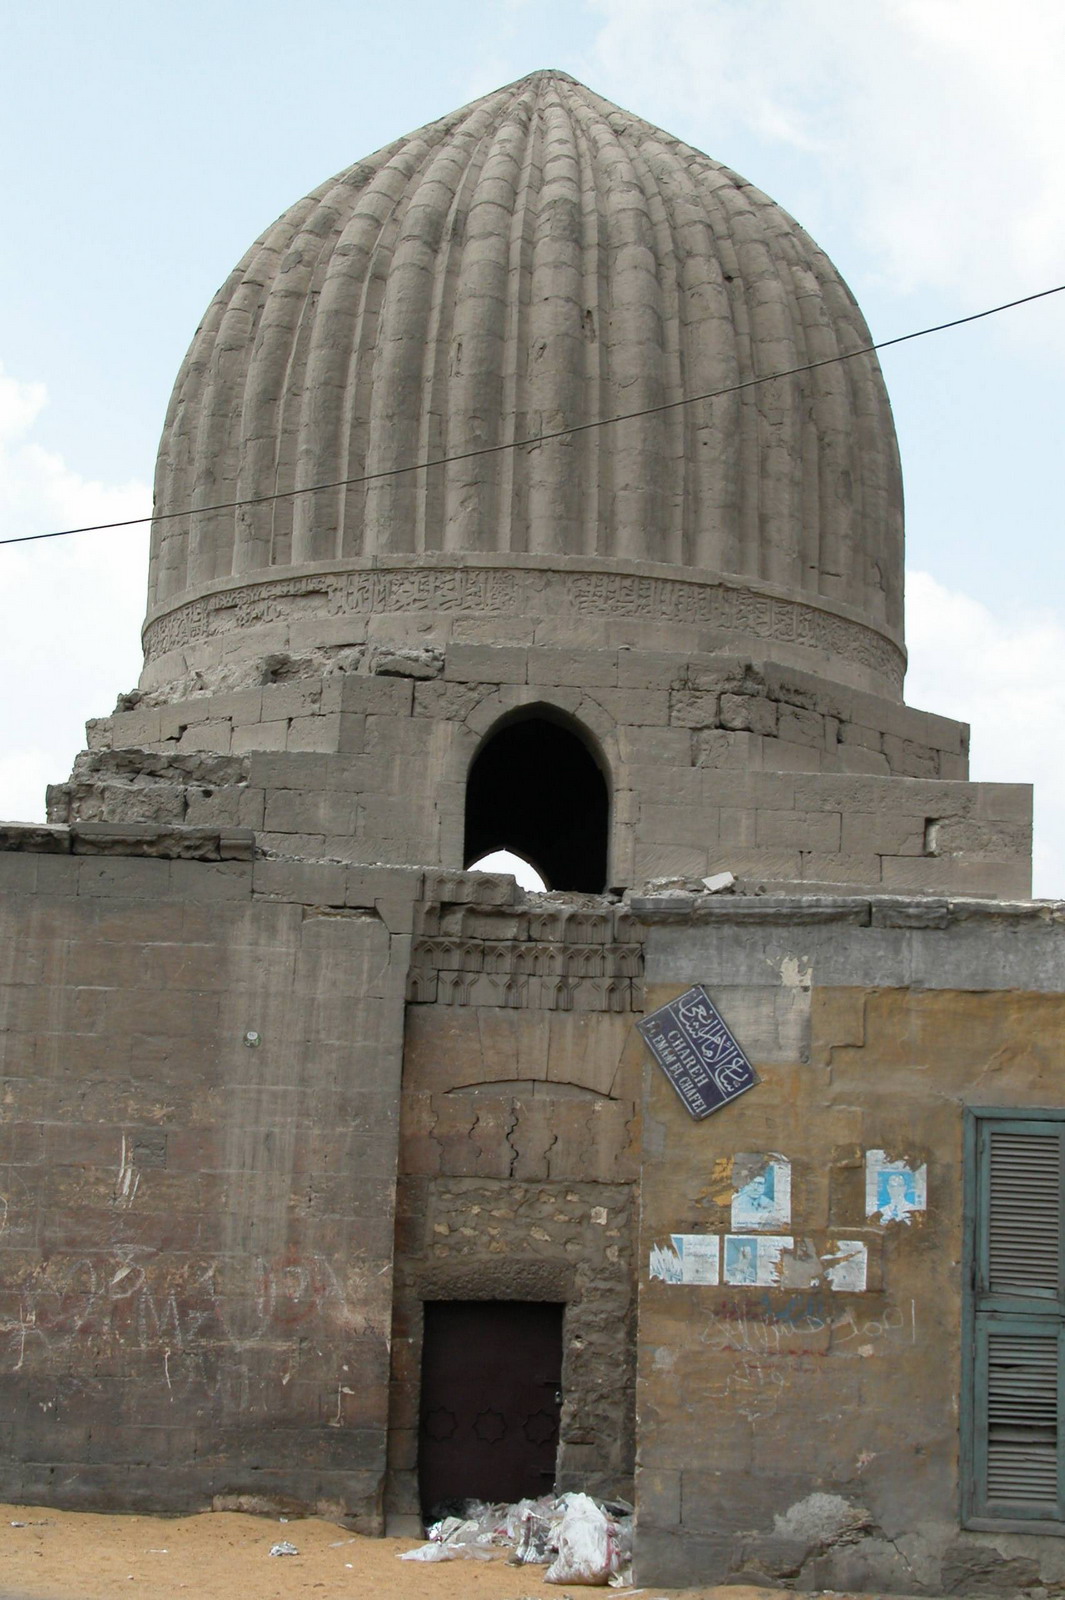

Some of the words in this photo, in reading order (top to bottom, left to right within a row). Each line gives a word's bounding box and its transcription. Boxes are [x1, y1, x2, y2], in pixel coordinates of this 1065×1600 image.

[653, 1034, 676, 1064] EMAM
[679, 1076, 707, 1112] CHAFEI
[668, 1030, 709, 1087] CHAREH
[715, 1057, 749, 1093] شارع
